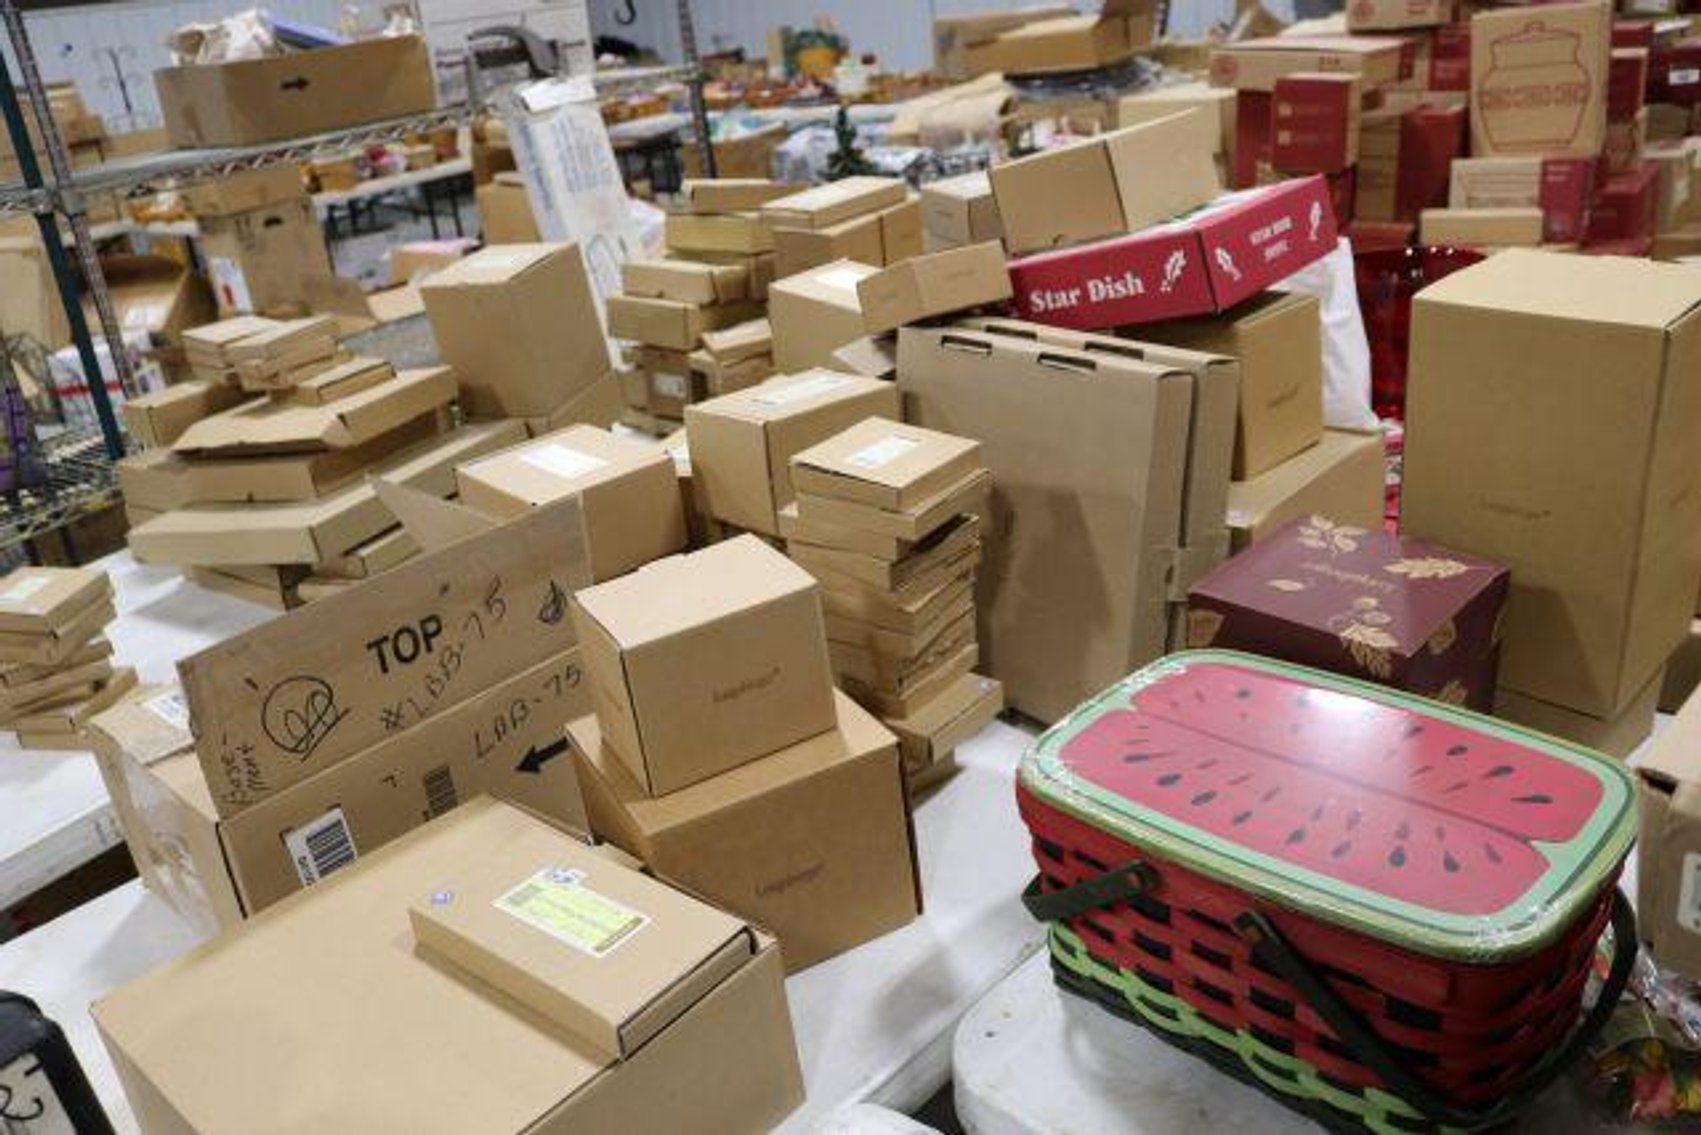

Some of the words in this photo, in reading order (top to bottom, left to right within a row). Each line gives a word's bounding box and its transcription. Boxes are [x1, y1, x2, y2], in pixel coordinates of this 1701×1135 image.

[1029, 284, 1082, 313] Star
[1087, 271, 1146, 303] Dish
[367, 613, 443, 675] TOP
